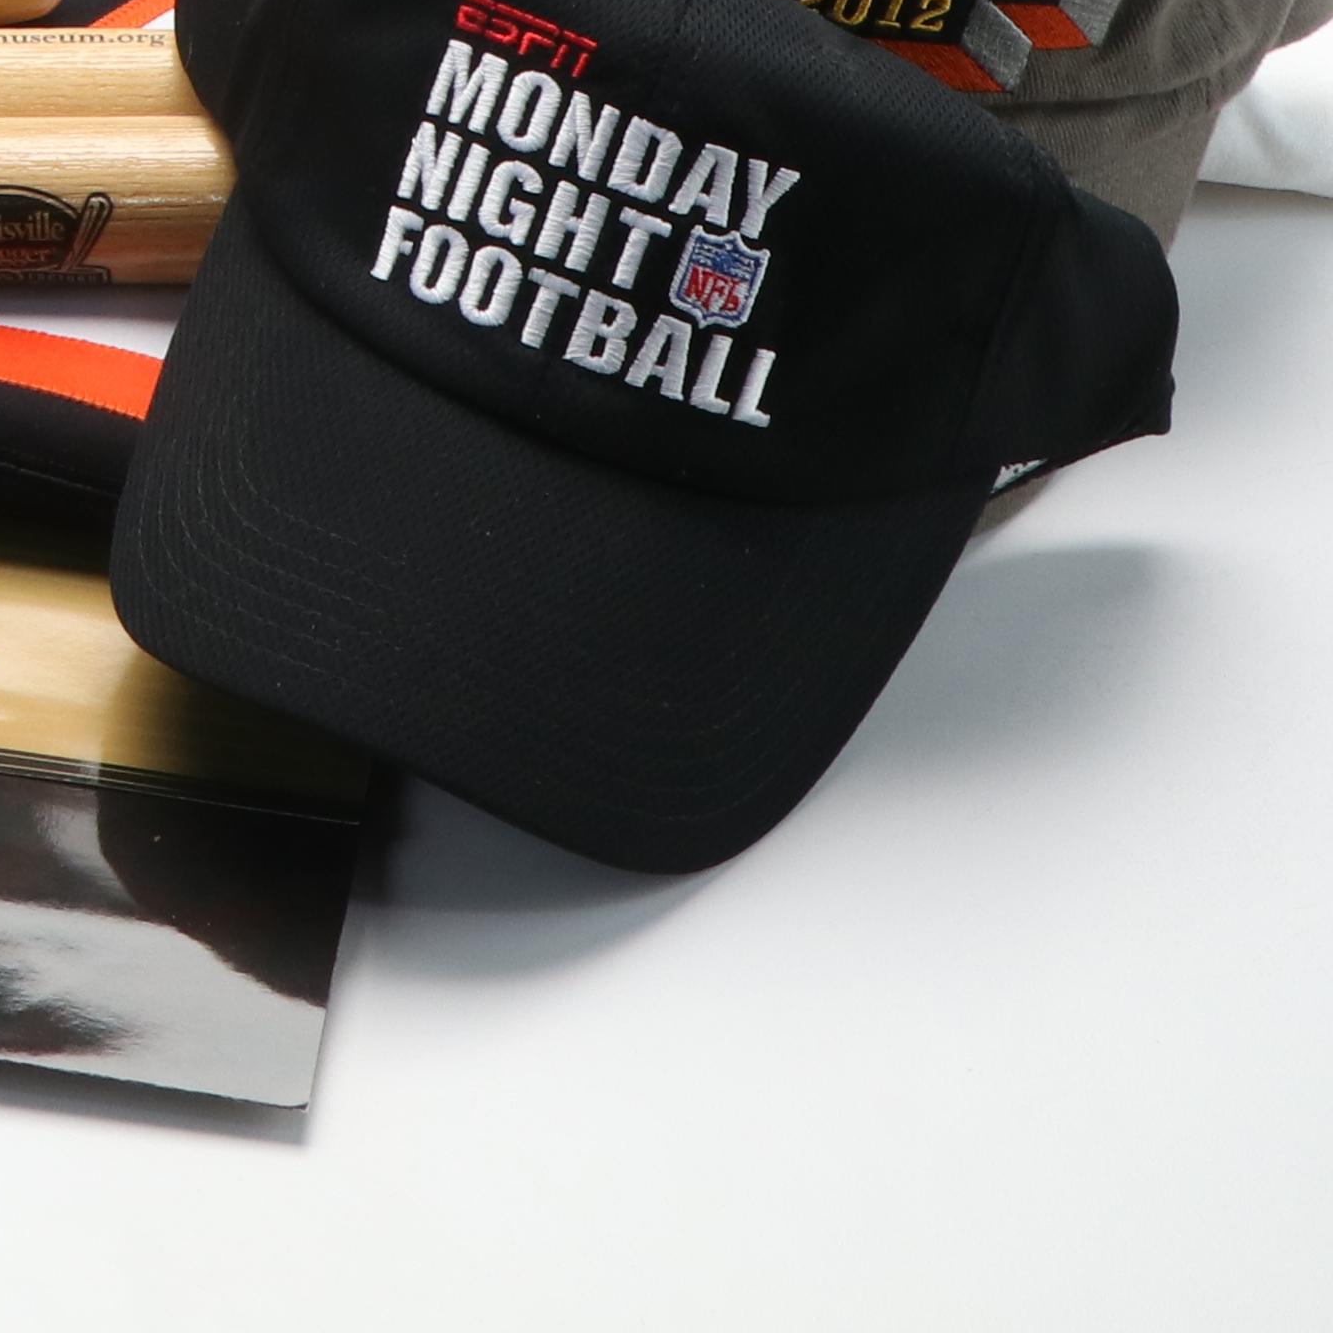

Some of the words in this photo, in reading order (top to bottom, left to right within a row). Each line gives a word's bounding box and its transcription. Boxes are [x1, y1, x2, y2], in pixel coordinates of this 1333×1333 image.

[397, 121, 673, 290] NIGHT
[425, 38, 802, 239] MONDAY
[369, 205, 777, 429] FOOTBALL
